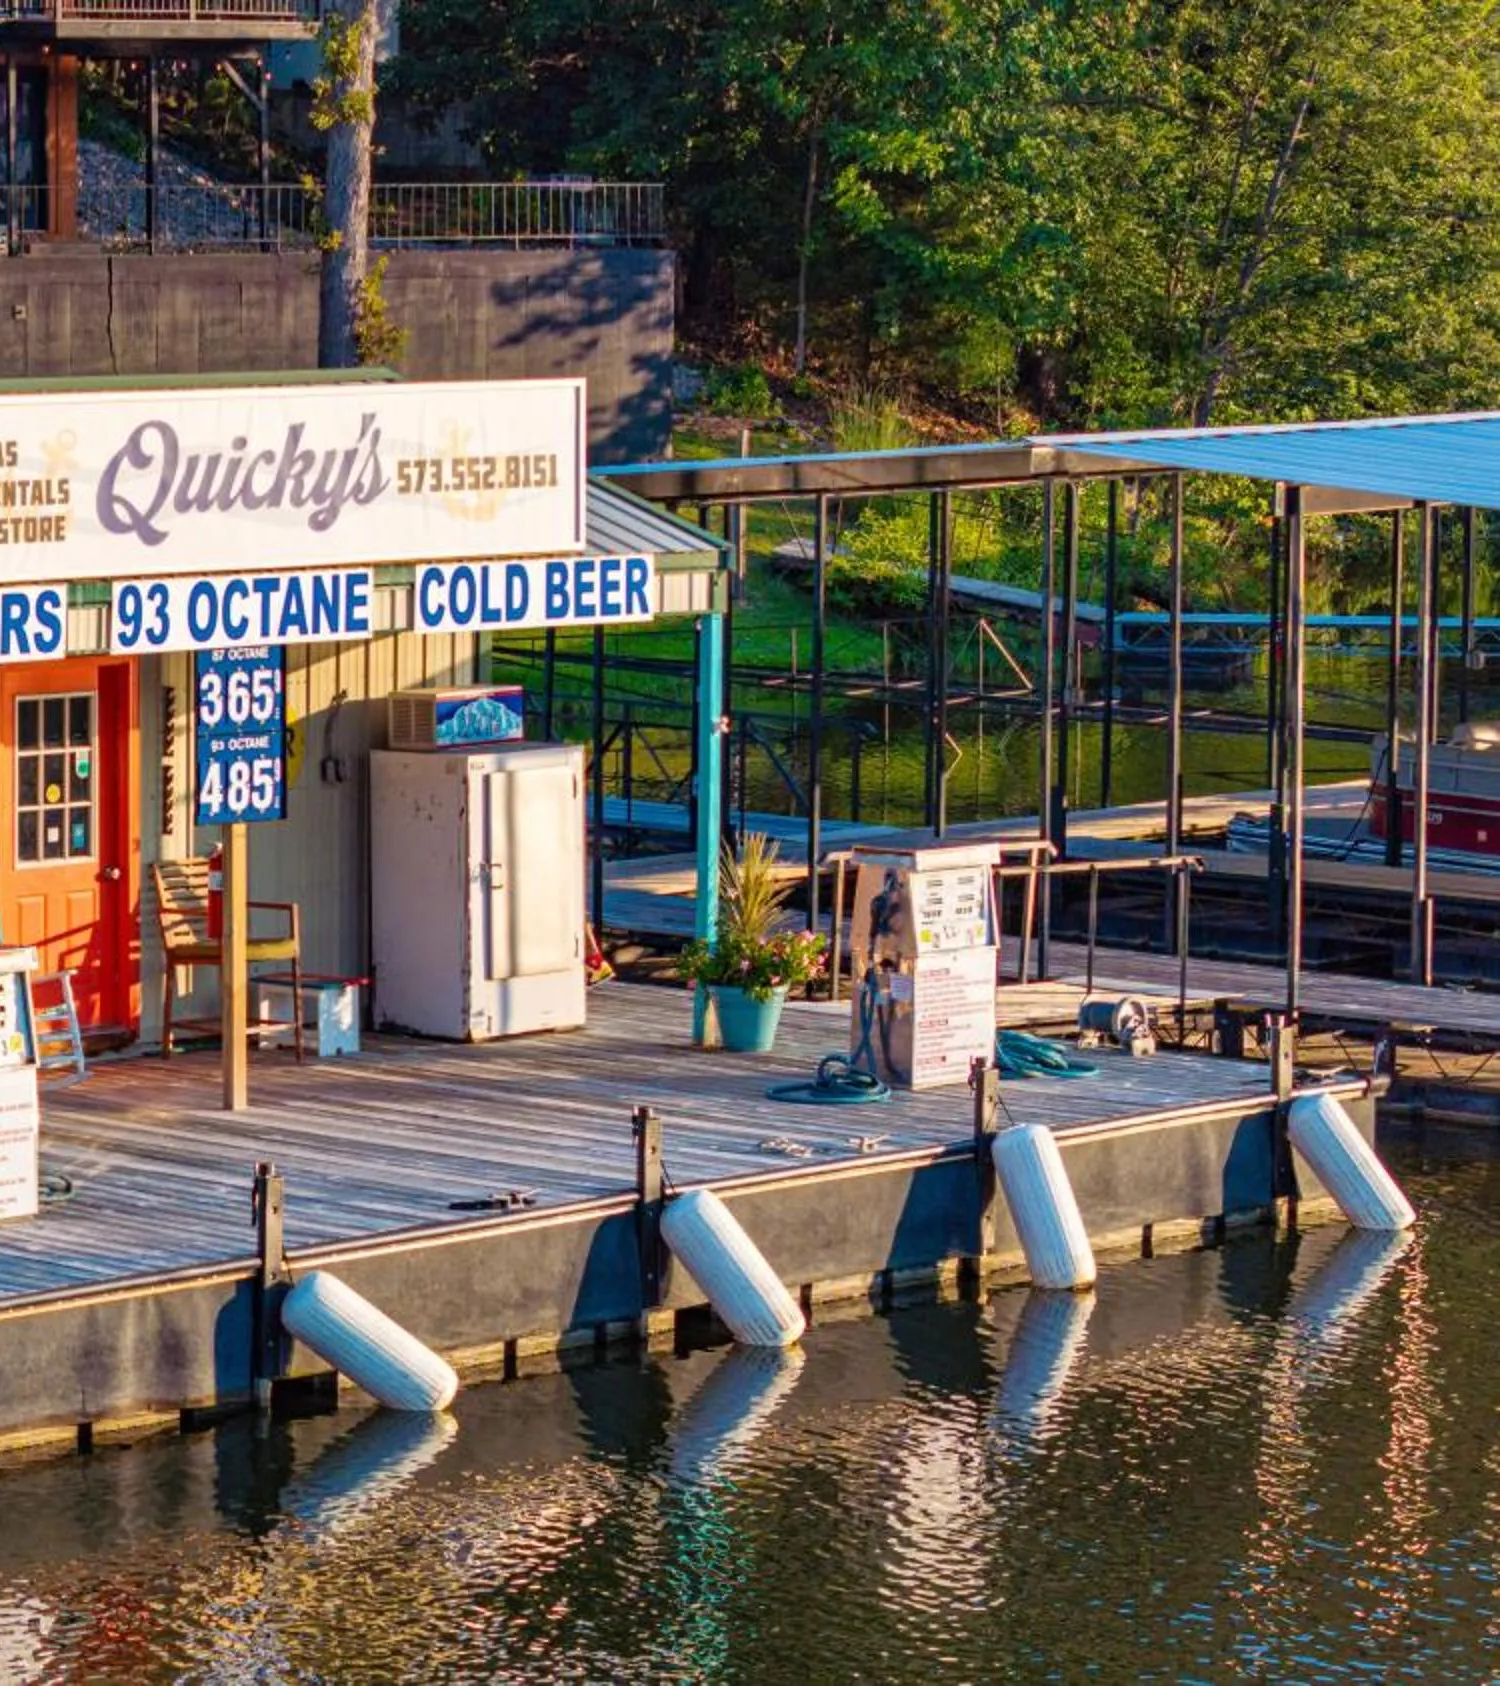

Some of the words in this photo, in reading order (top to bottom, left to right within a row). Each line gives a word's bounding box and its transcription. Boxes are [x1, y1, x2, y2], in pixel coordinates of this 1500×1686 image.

[96, 412, 391, 547] Quicky's
[396, 453, 559, 495] 573.552.8151
[117, 583, 170, 647] 93
[187, 571, 369, 643] OCTANE
[418, 563, 530, 628] COLD
[544, 557, 650, 620] BEER
[227, 646, 270, 661] OCTANE
[199, 668, 274, 726] 365
[211, 739, 225, 751] 93
[227, 735, 270, 750] OCTANE
[199, 758, 274, 816] 485
